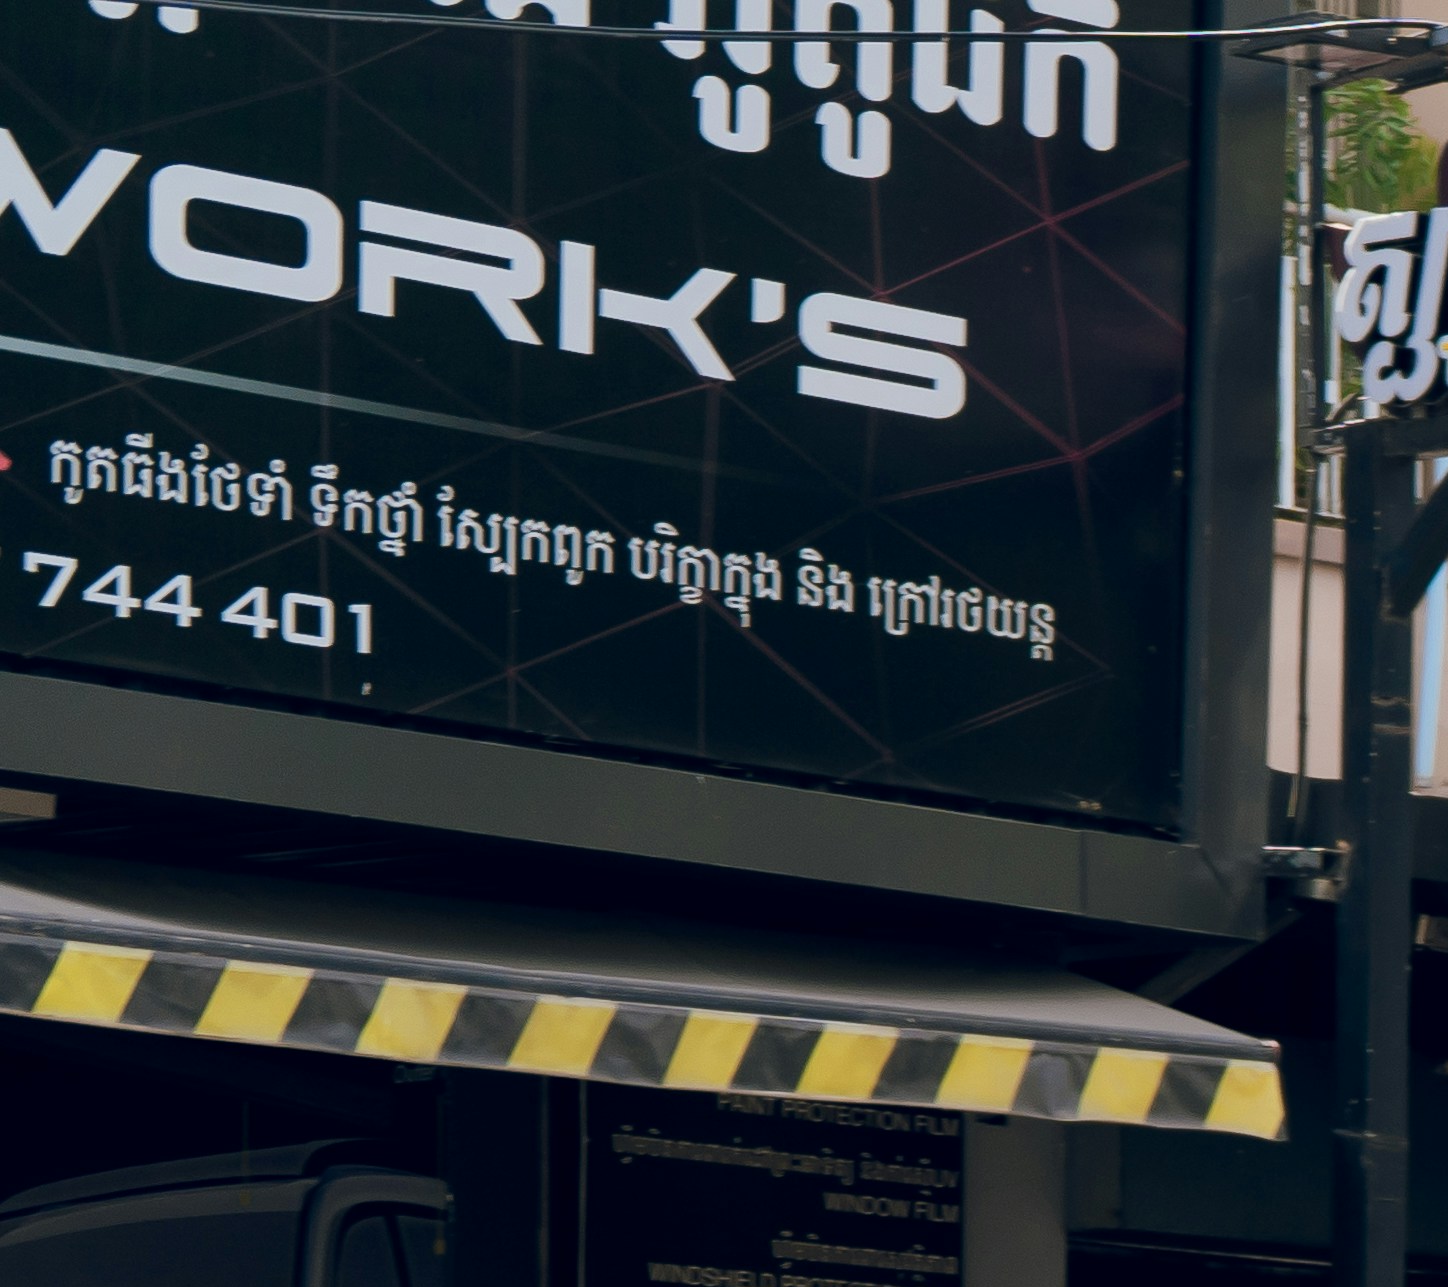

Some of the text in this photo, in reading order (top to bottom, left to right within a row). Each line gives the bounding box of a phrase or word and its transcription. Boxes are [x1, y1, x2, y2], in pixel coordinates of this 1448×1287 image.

[22, 551, 372, 655] 744 401
[797, 547, 856, 613] និង
[781, 1099, 911, 1134] PROTECTION
[914, 1113, 961, 1138] FILM
[823, 1191, 961, 1225] WINDOW FILM
